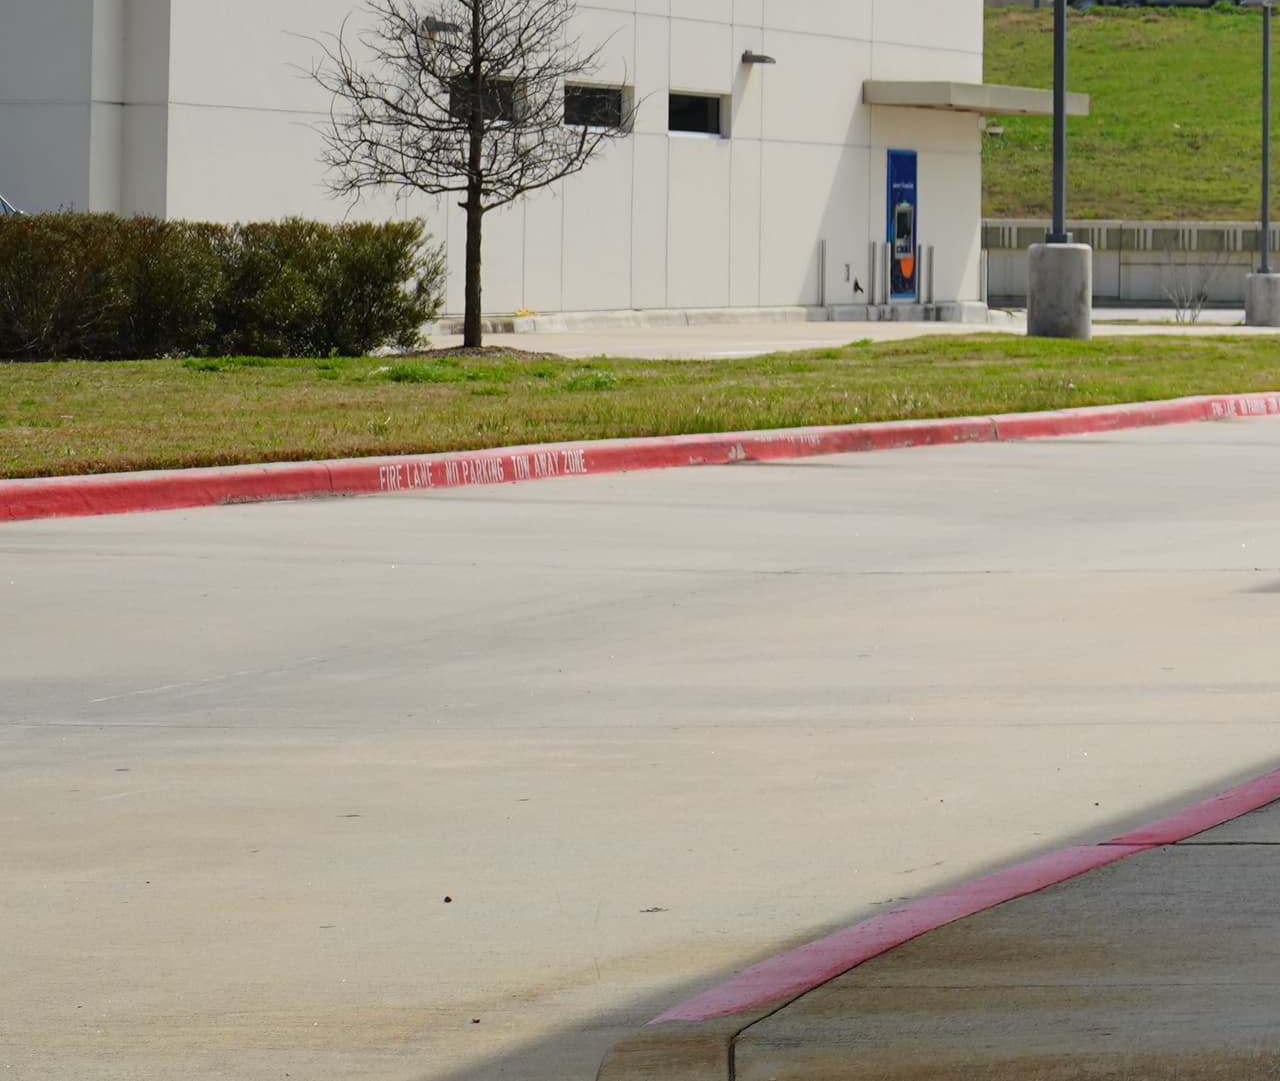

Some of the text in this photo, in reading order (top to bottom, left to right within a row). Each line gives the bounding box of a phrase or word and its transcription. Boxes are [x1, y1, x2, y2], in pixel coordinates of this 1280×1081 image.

[379, 448, 587, 492] FIRE LANE NO PARKING TOW AWAY ZONE
